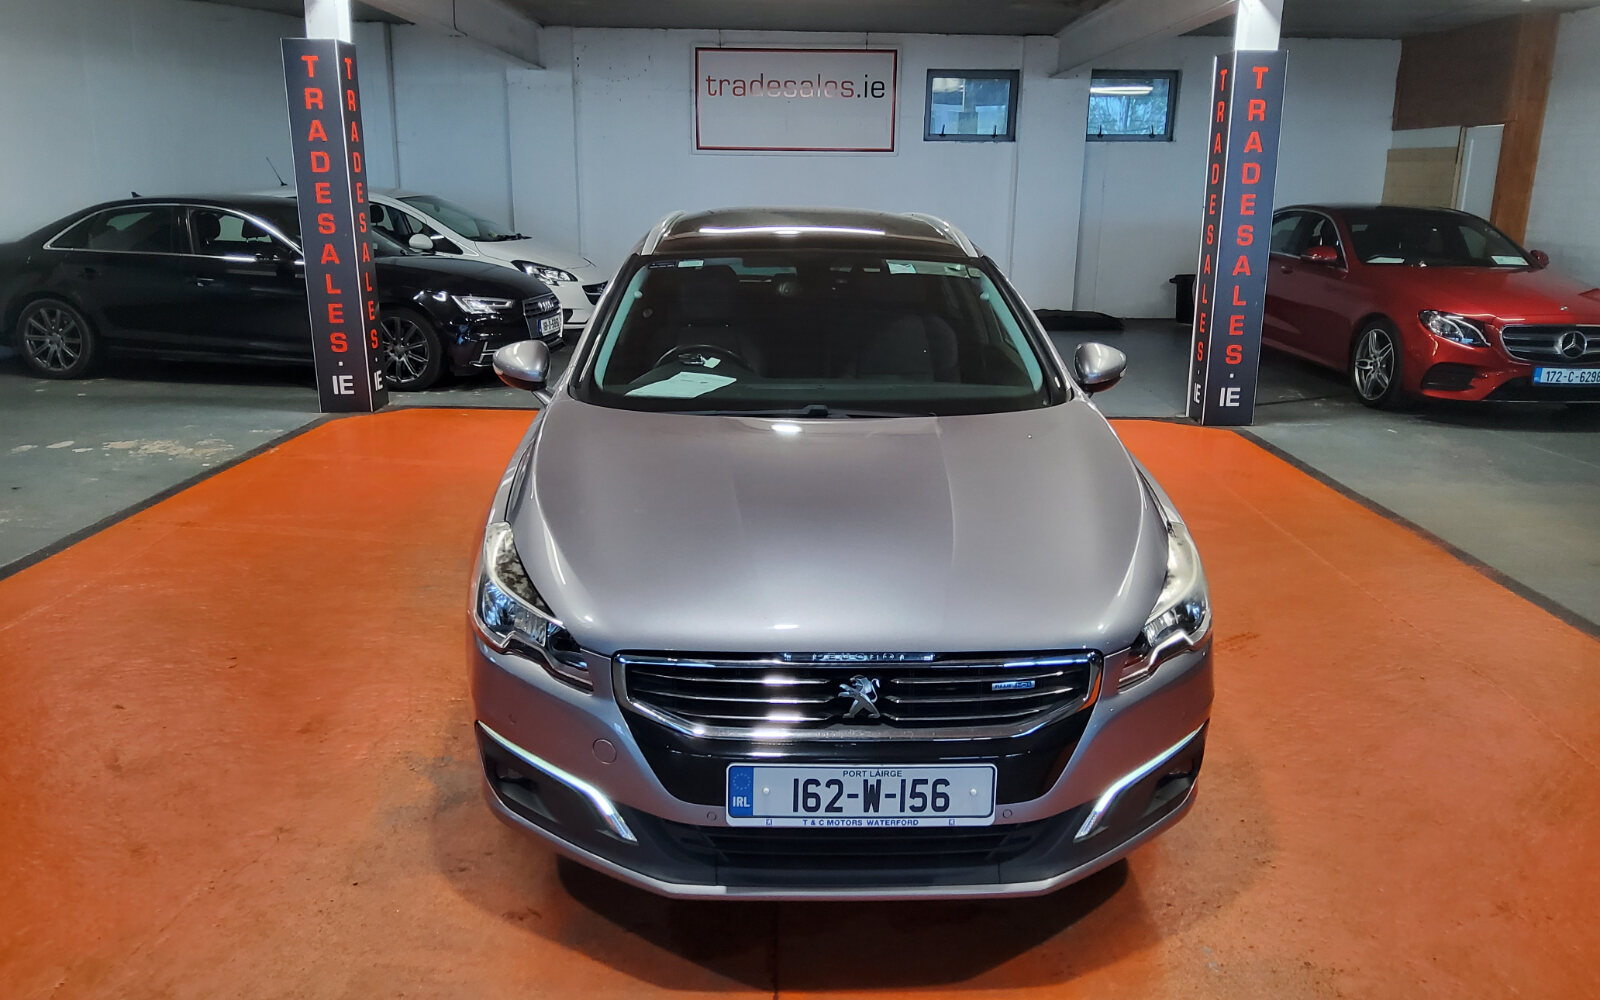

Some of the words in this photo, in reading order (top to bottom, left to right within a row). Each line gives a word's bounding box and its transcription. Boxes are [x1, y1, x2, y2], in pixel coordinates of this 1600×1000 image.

[705, 73, 885, 98] tradesales.ie
[732, 796, 751, 808] IRL
[793, 778, 951, 813] 162-W-156
